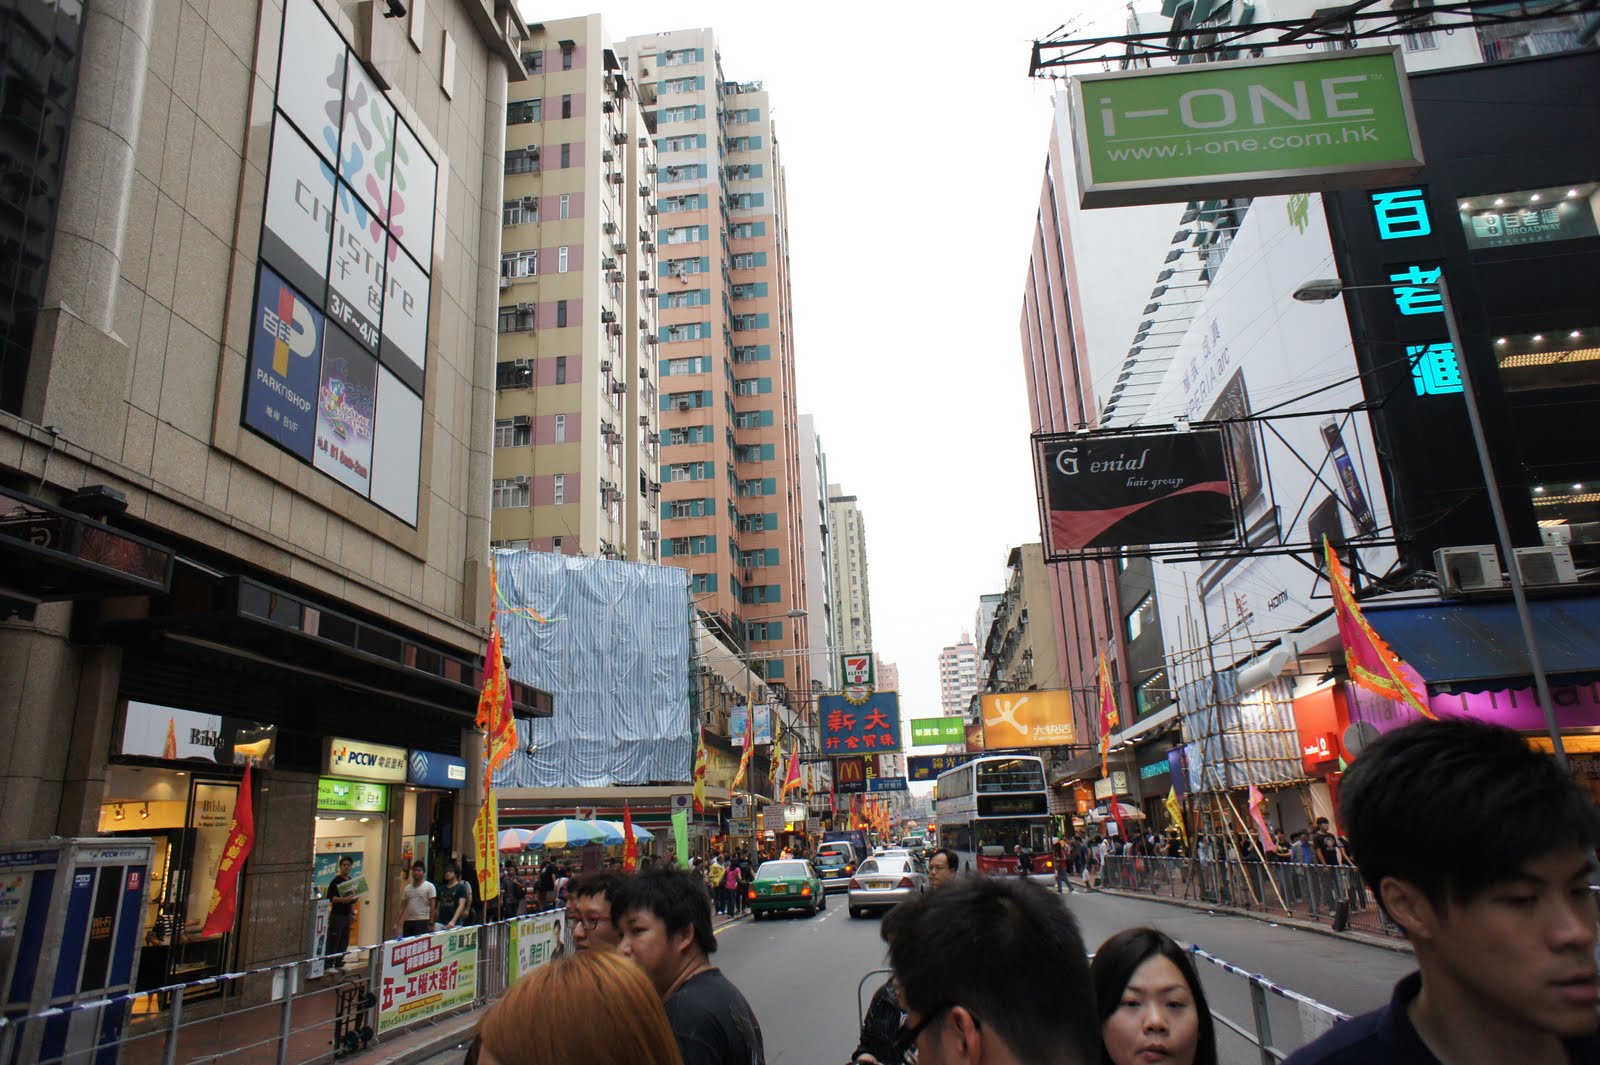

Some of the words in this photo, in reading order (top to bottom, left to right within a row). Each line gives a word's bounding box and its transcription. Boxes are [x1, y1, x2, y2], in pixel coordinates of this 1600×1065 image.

[1107, 126, 1379, 162] www.i-one.com.hk
[1506, 223, 1560, 235] BROADWAY
[1126, 477, 1149, 487] hair
[1149, 477, 1184, 489] group
[847, 658, 867, 670] 7
[189, 727, 225, 749] Bibba
[348, 751, 378, 767] PCCW
[203, 799, 227, 812] Bibba
